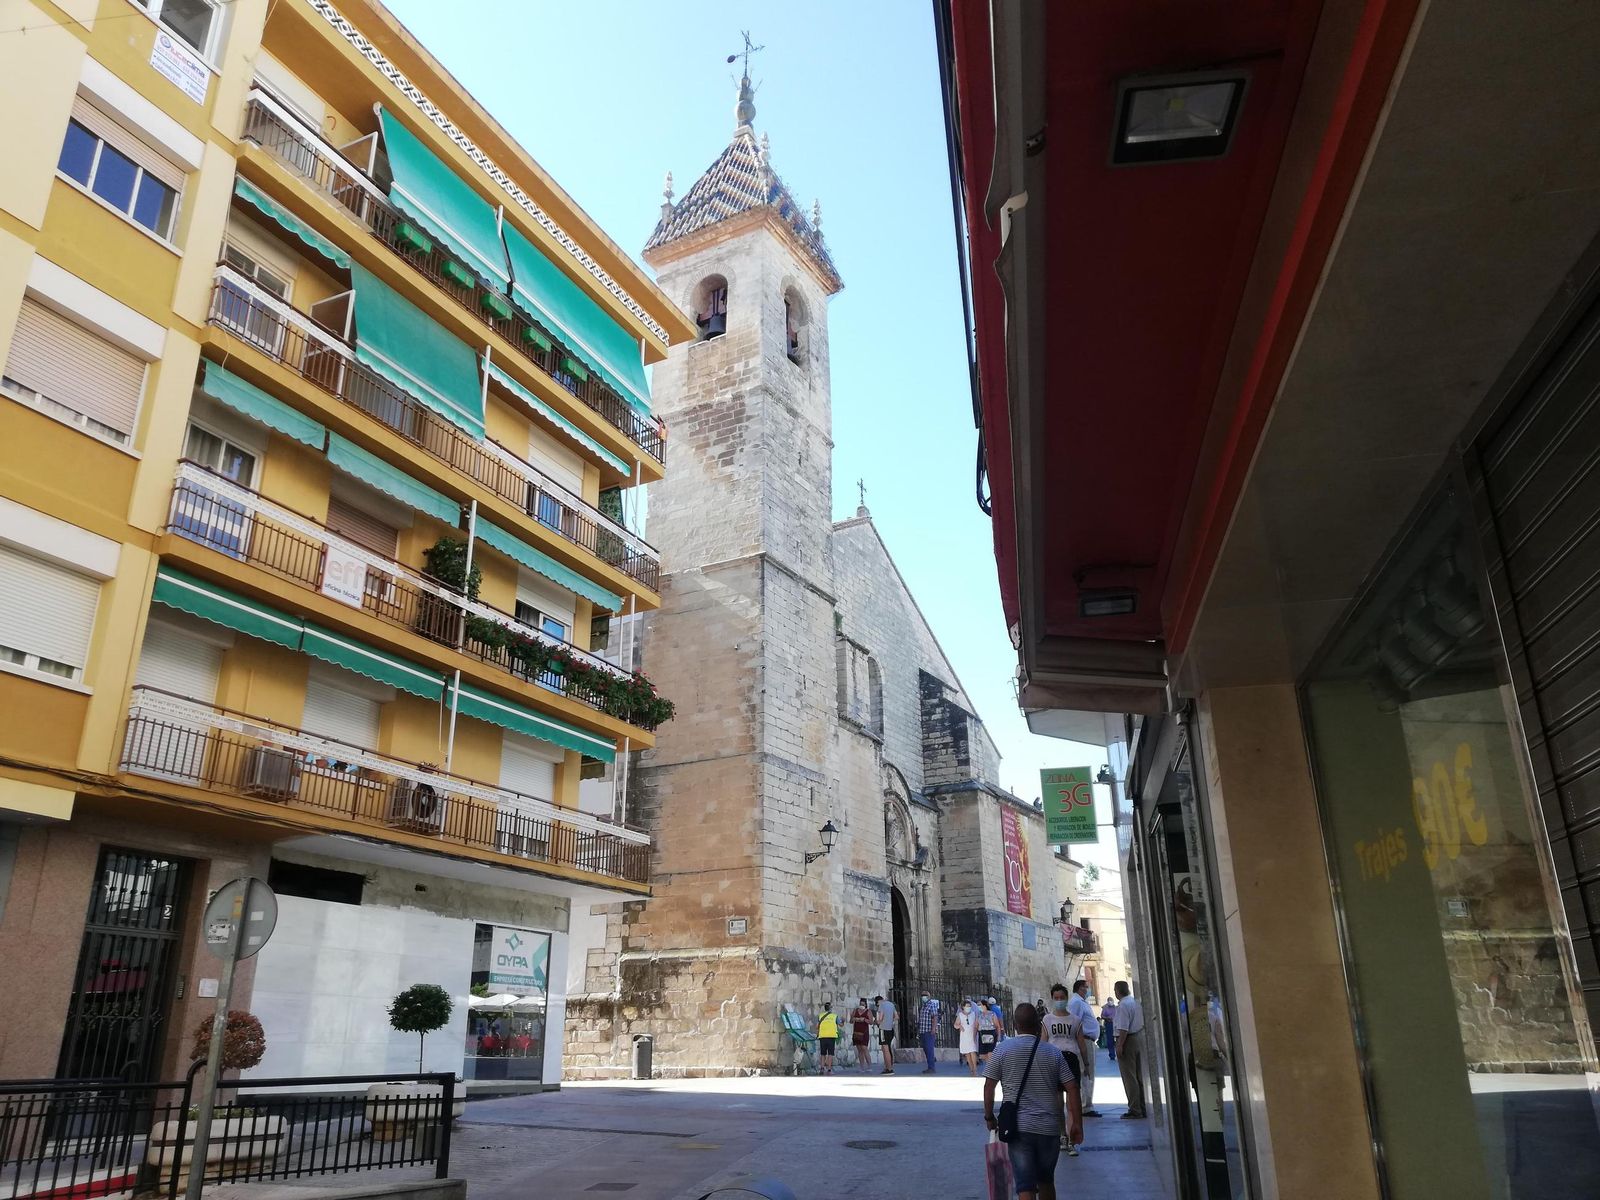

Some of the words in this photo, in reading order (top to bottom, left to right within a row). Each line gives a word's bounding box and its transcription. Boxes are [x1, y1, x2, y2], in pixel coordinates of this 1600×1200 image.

[1057, 782, 1093, 814] 3G
[1355, 828, 1408, 882] Trajes
[1412, 743, 1488, 870] 90€
[497, 954, 529, 969] OYPA
